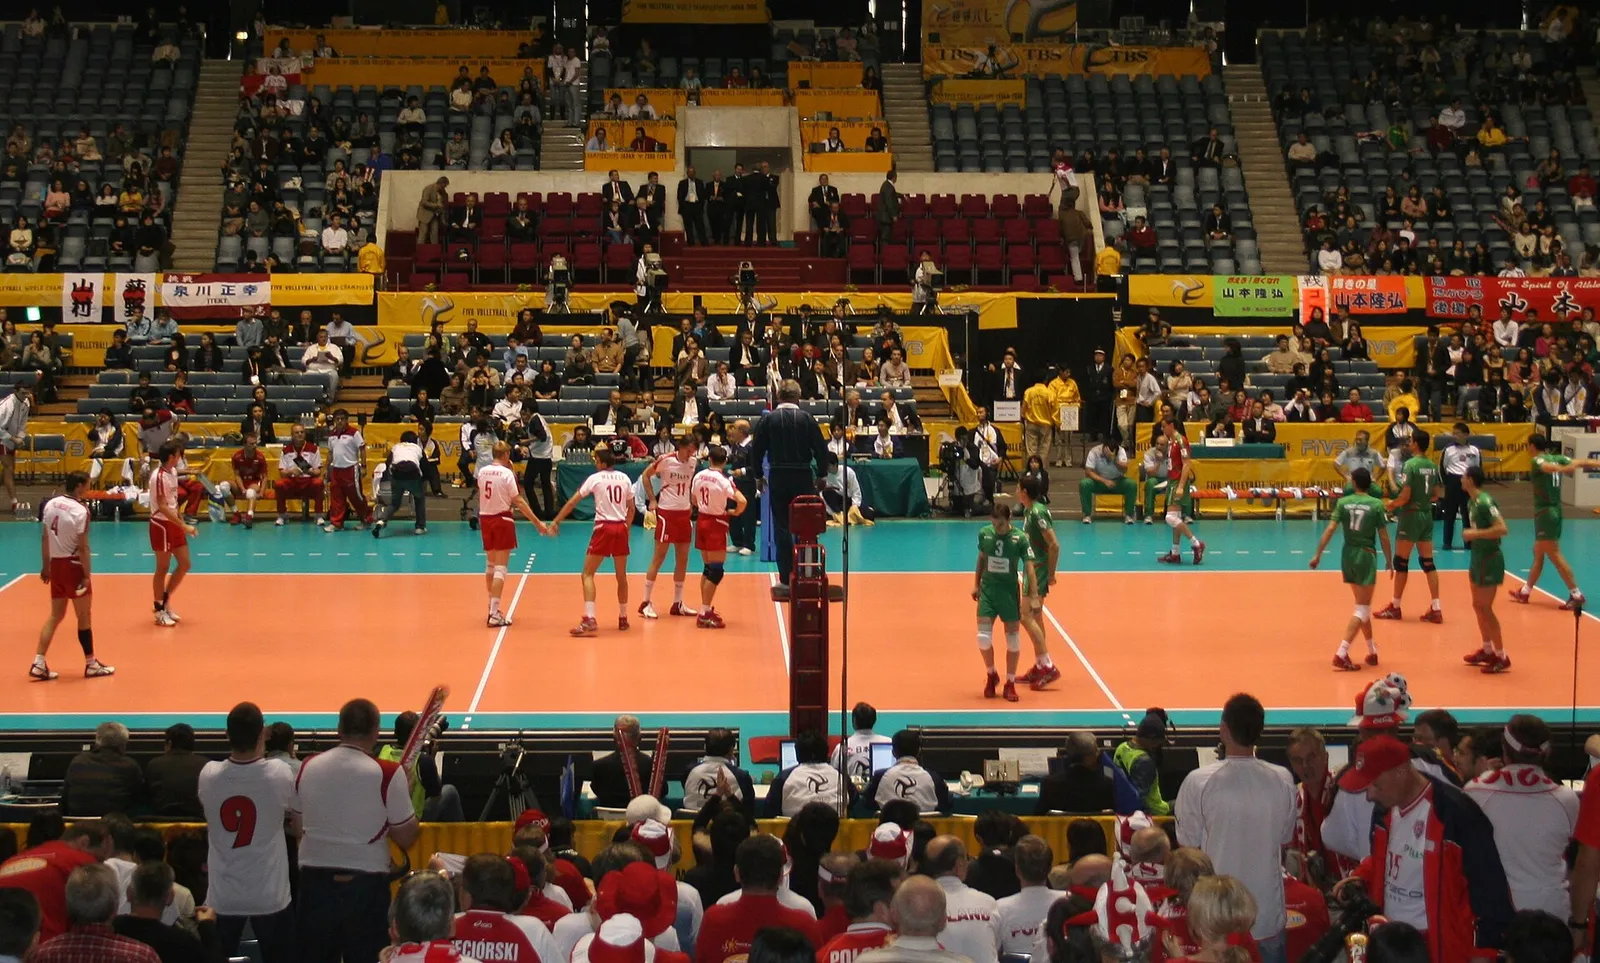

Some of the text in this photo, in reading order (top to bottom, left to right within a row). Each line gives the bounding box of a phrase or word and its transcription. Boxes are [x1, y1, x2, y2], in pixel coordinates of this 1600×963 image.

[953, 8, 999, 22] 世界バレー
[935, 48, 974, 61] TBS
[1023, 49, 1061, 61] TBS
[1110, 49, 1148, 62] TBS
[1332, 278, 1377, 290] 輝きの星
[1497, 280, 1517, 289] The
[1521, 280, 1552, 291] Spirit
[1556, 280, 1569, 291] Of
[1222, 287, 1284, 299] 山本隆弘
[1335, 292, 1404, 309] 山本隆弘
[1433, 300, 1484, 315] 後援
[1498, 291, 1582, 317] 山本
[463, 307, 475, 316] FIVB
[476, 308, 508, 318] VOLLEYBALL
[75, 340, 108, 349] VOLLEYBALL
[670, 472, 690, 480] Plus
[484, 480, 492, 499] 5
[676, 482, 686, 497] 11
[1206, 480, 1221, 490] FIVB
[1224, 480, 1264, 490] VOLLEYBALL
[606, 484, 622, 504] 10
[700, 486, 710, 506] 13
[51, 515, 59, 536] 4
[1349, 509, 1365, 531] 17
[994, 539, 1004, 556] 3
[219, 795, 257, 849] 9
[1388, 851, 1402, 880] 15
